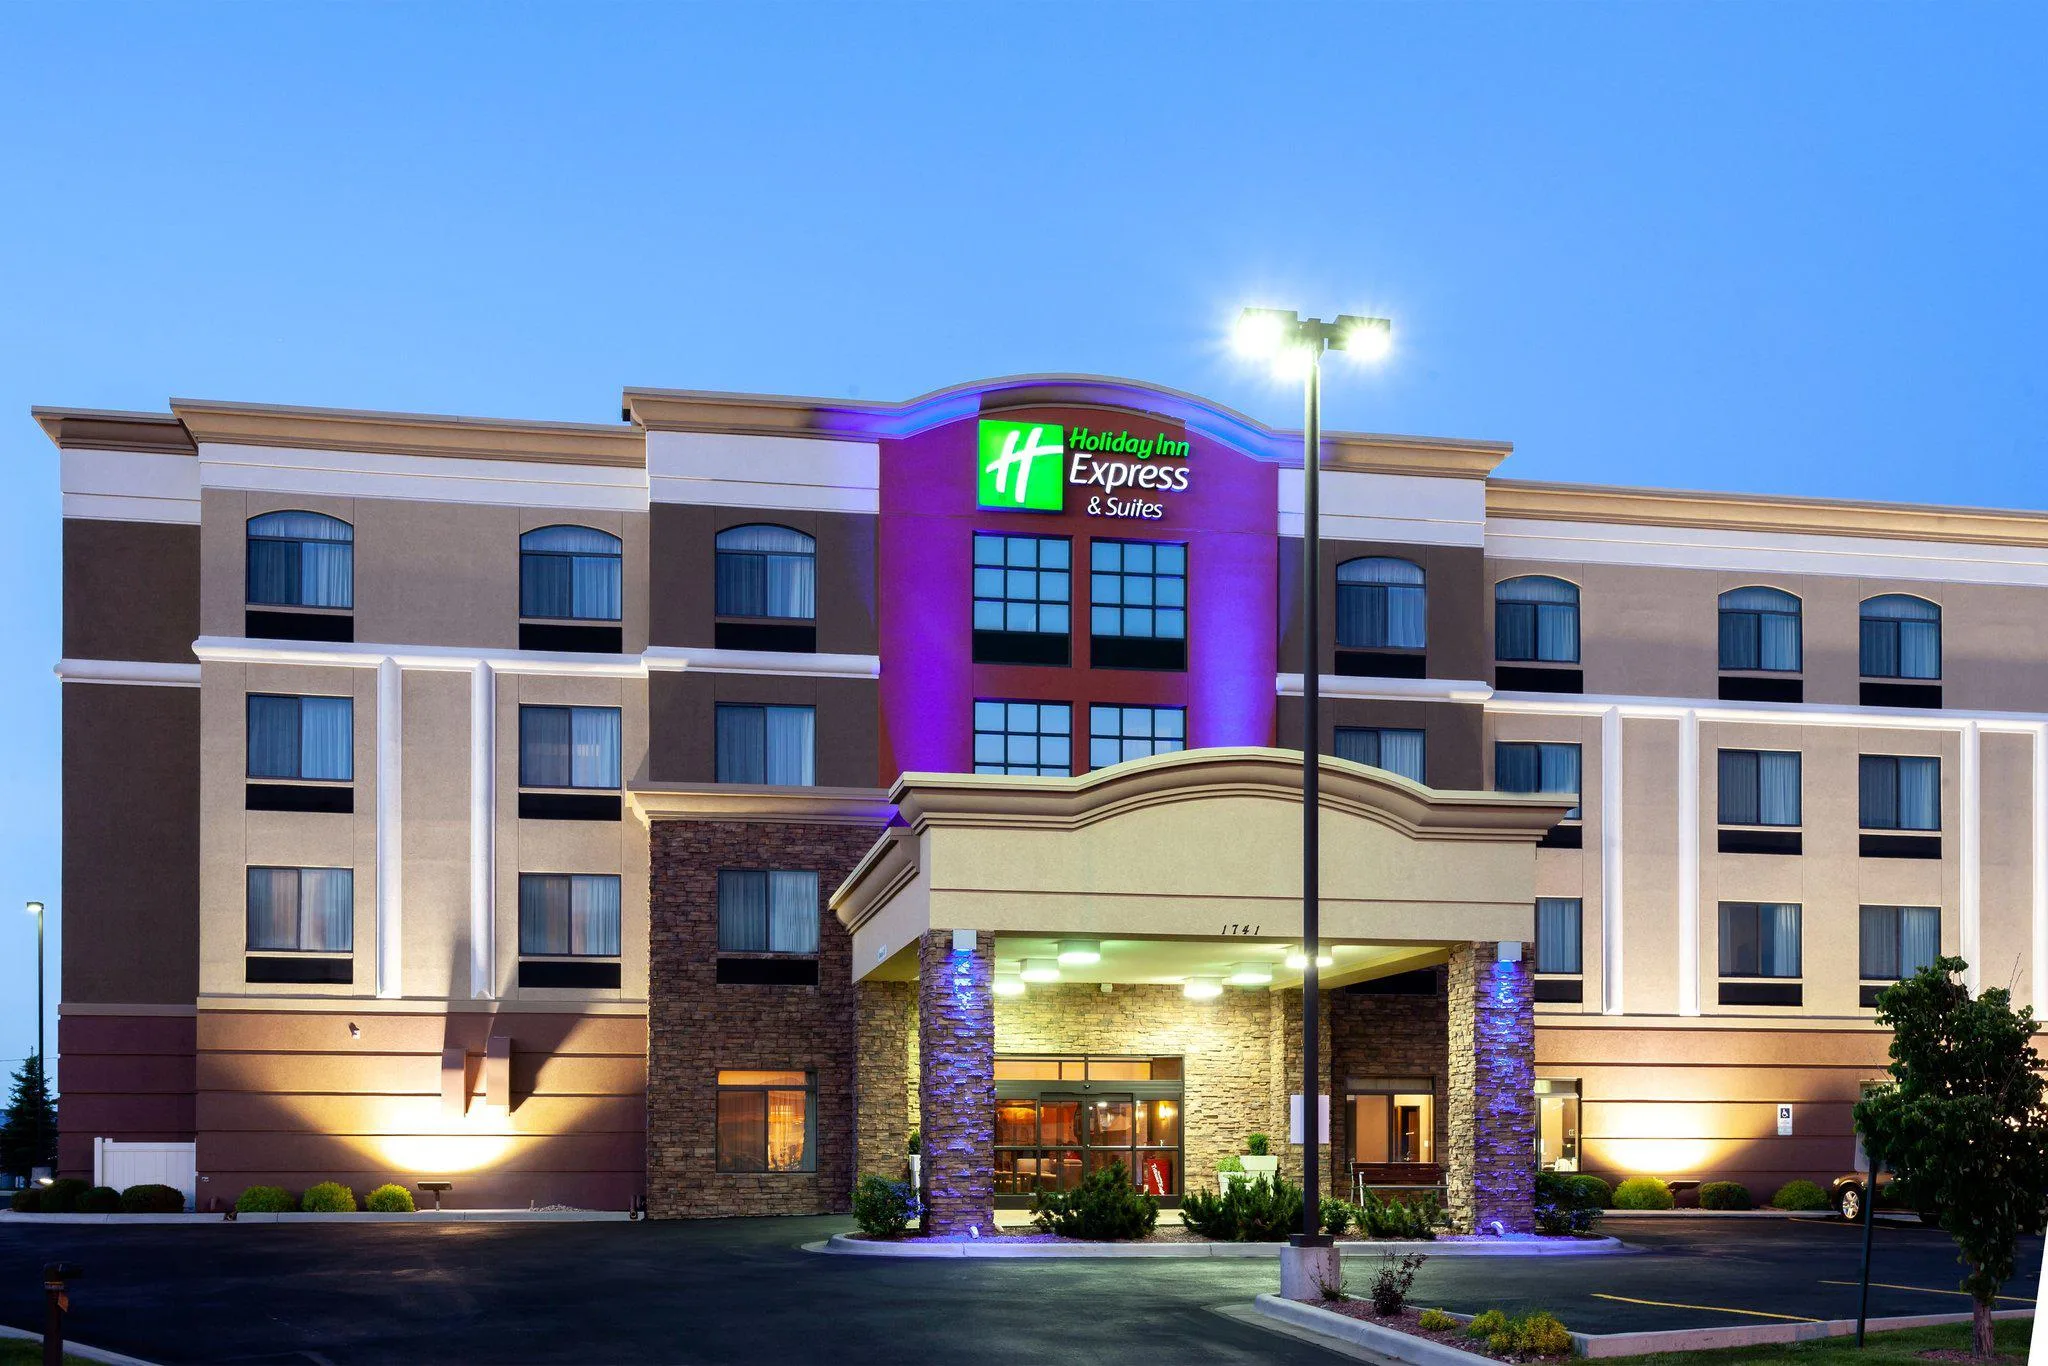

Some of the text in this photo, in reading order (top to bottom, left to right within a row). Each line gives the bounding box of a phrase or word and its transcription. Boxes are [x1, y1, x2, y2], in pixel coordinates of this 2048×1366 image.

[1069, 427, 1190, 459] Holiday Inn
[1069, 453, 1190, 494] Express
[1087, 496, 1163, 518] & Suites
[1221, 924, 1260, 935] 1741
